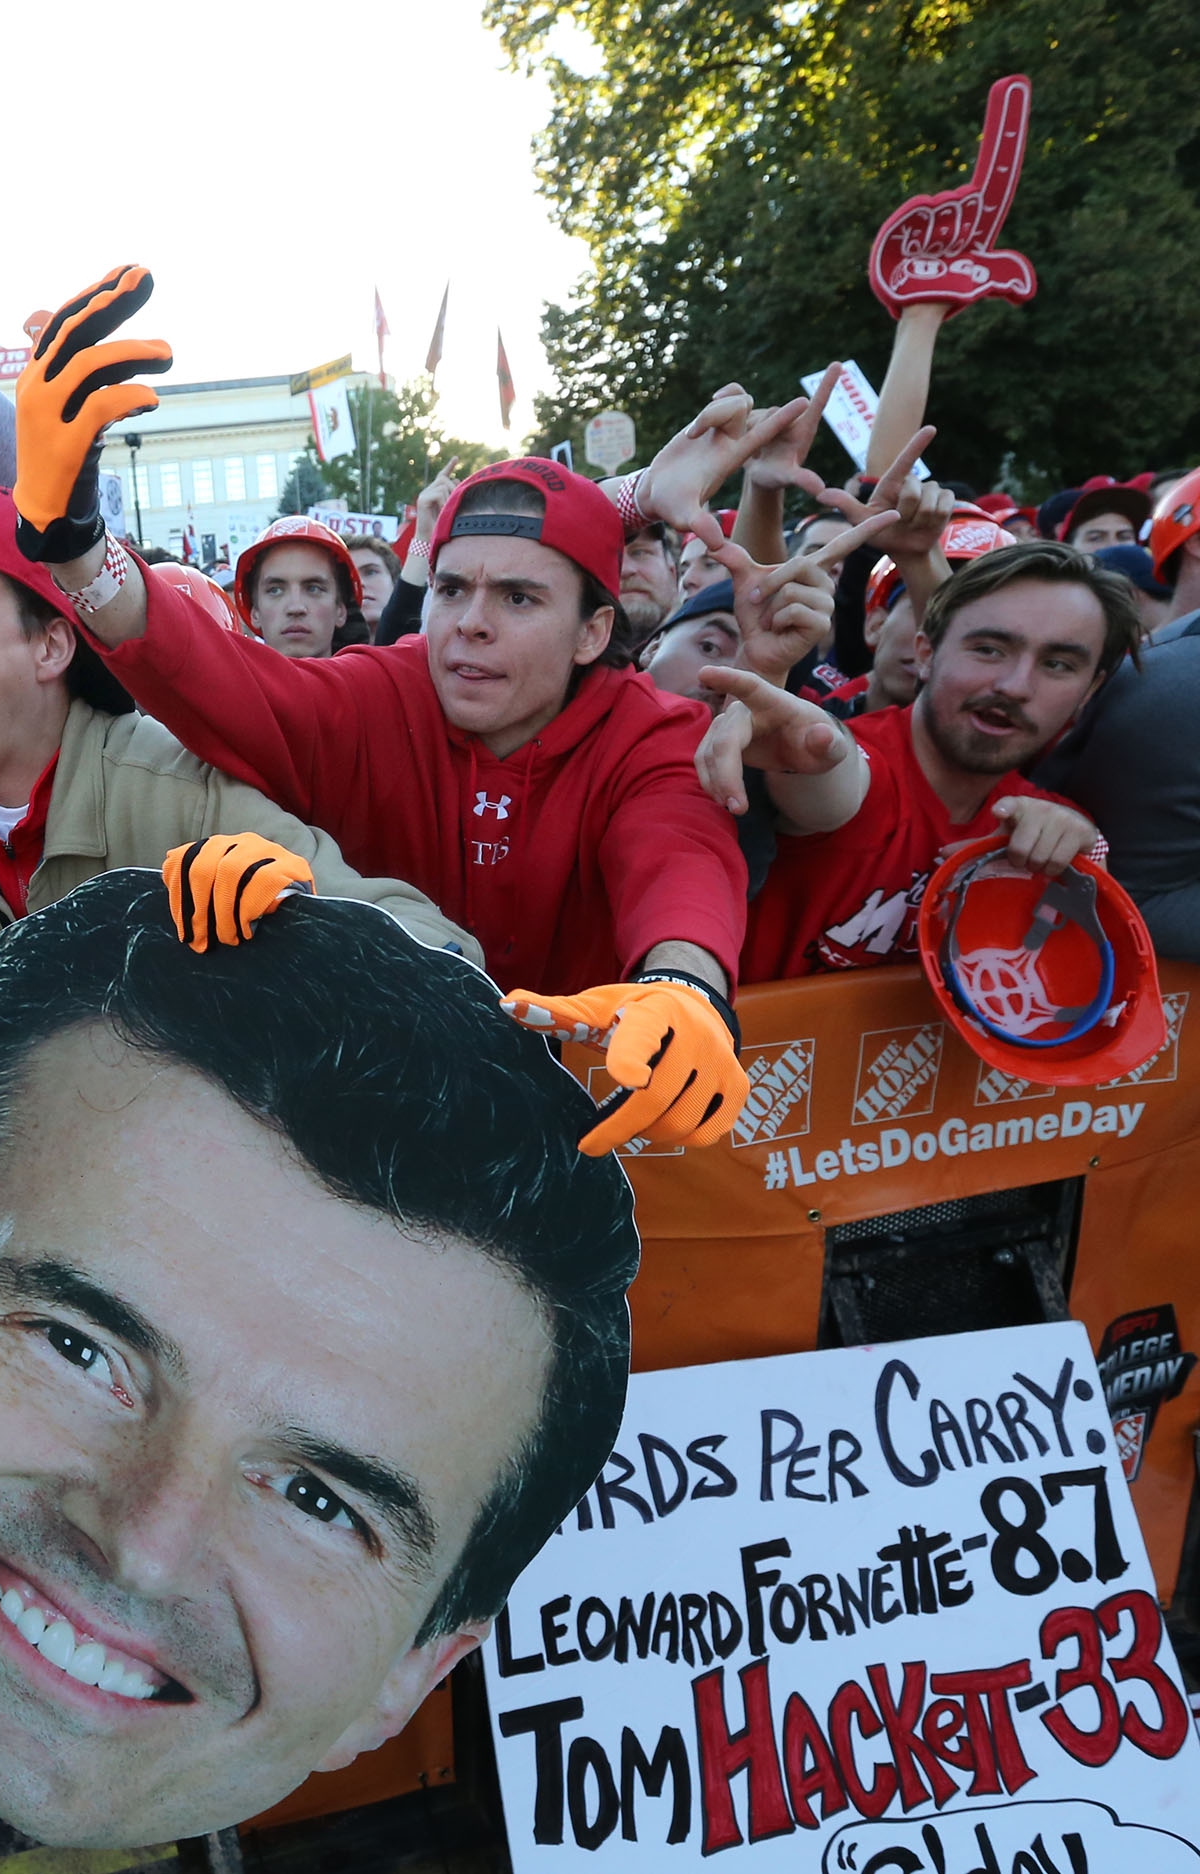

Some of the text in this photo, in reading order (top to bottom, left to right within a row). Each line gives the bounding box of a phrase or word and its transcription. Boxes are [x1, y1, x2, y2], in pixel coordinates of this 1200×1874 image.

[731, 1040, 814, 1143] HOME
[855, 1023, 943, 1122] HOME
[867, 1039, 903, 1078] THE
[885, 1056, 939, 1118] DEPOT
[760, 1074, 812, 1138] DEPOT
[763, 1101, 1146, 1191] #LetsDoGameDay
[759, 1408, 870, 1503] PER
[873, 1357, 1107, 1488] CARRY:
[494, 1590, 744, 1679] LEONARD
[498, 1695, 693, 1851] TOM
